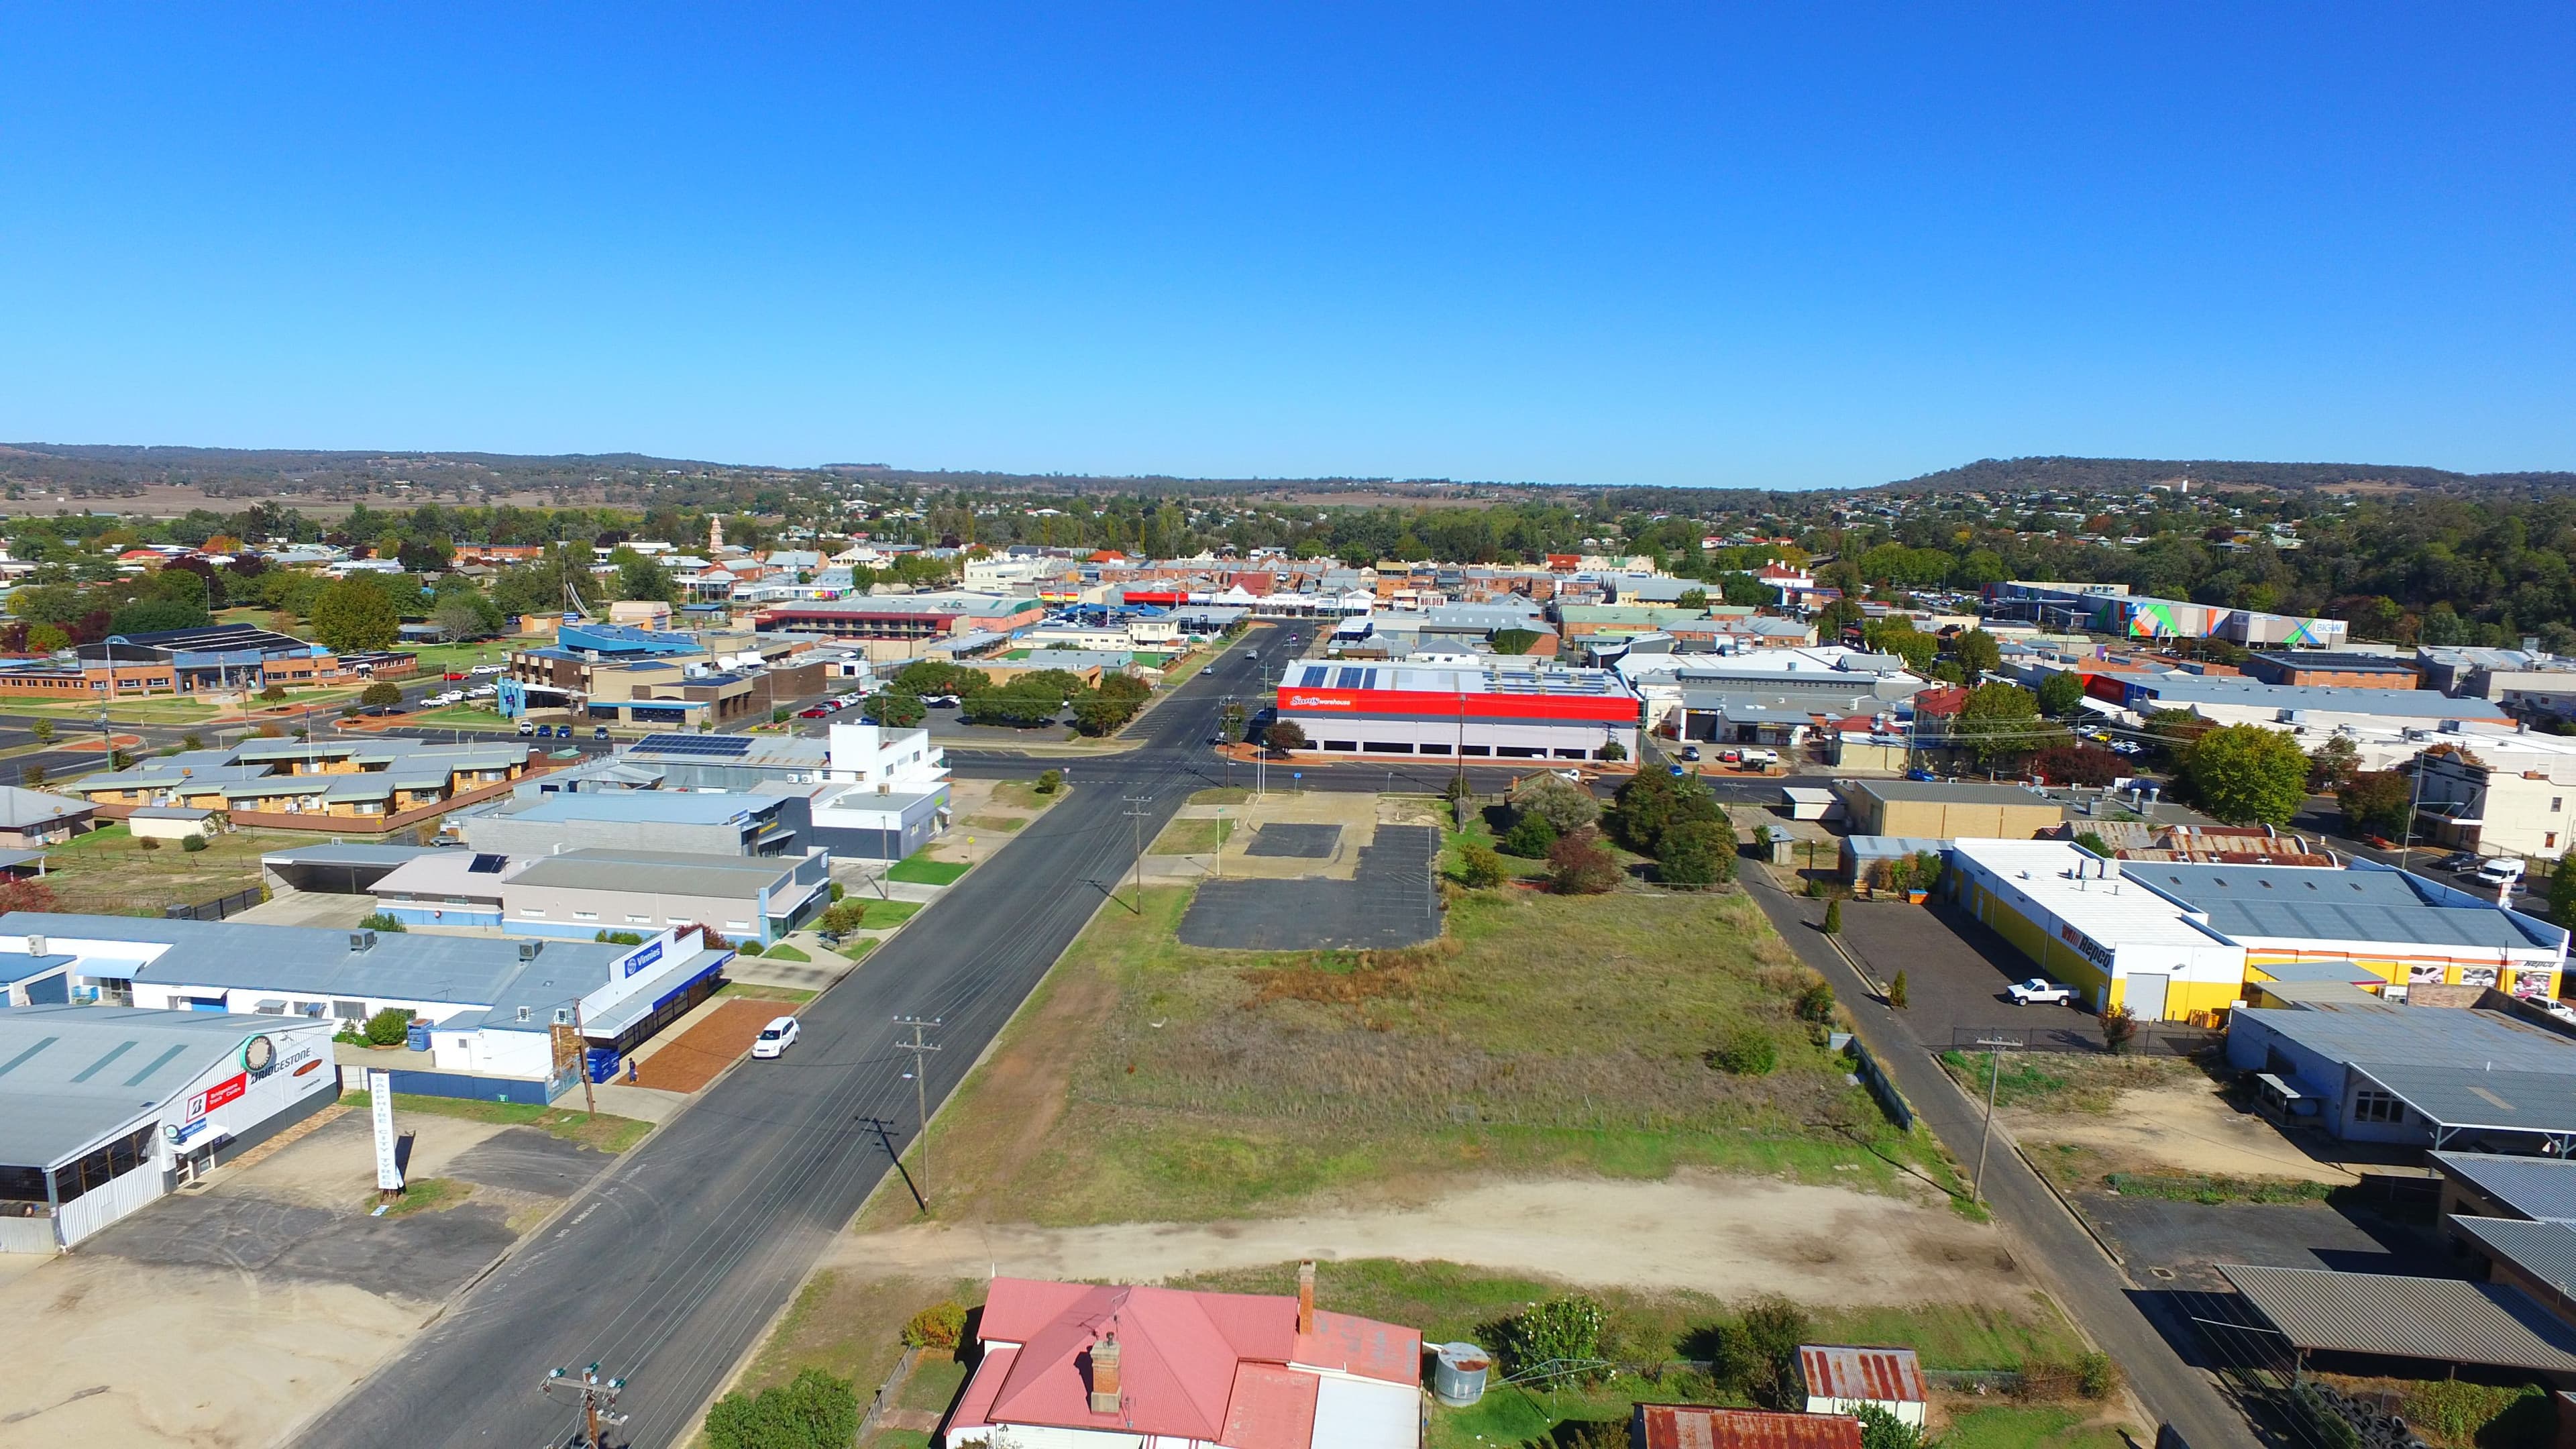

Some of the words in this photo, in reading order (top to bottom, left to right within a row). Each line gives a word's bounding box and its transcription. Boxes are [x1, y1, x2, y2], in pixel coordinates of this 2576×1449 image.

[1421, 598, 1444, 606] HOLDEN
[637, 949, 661, 966] Vinnies
[2079, 934, 2111, 968] Repco
[250, 1046, 311, 1084] BRIDGESTONE
[210, 1083, 239, 1099] Bridgestone
[376, 1077, 386, 1124] SAPPHIRE
[378, 1130, 389, 1152] CITY
[380, 1158, 392, 1186] TYRES
